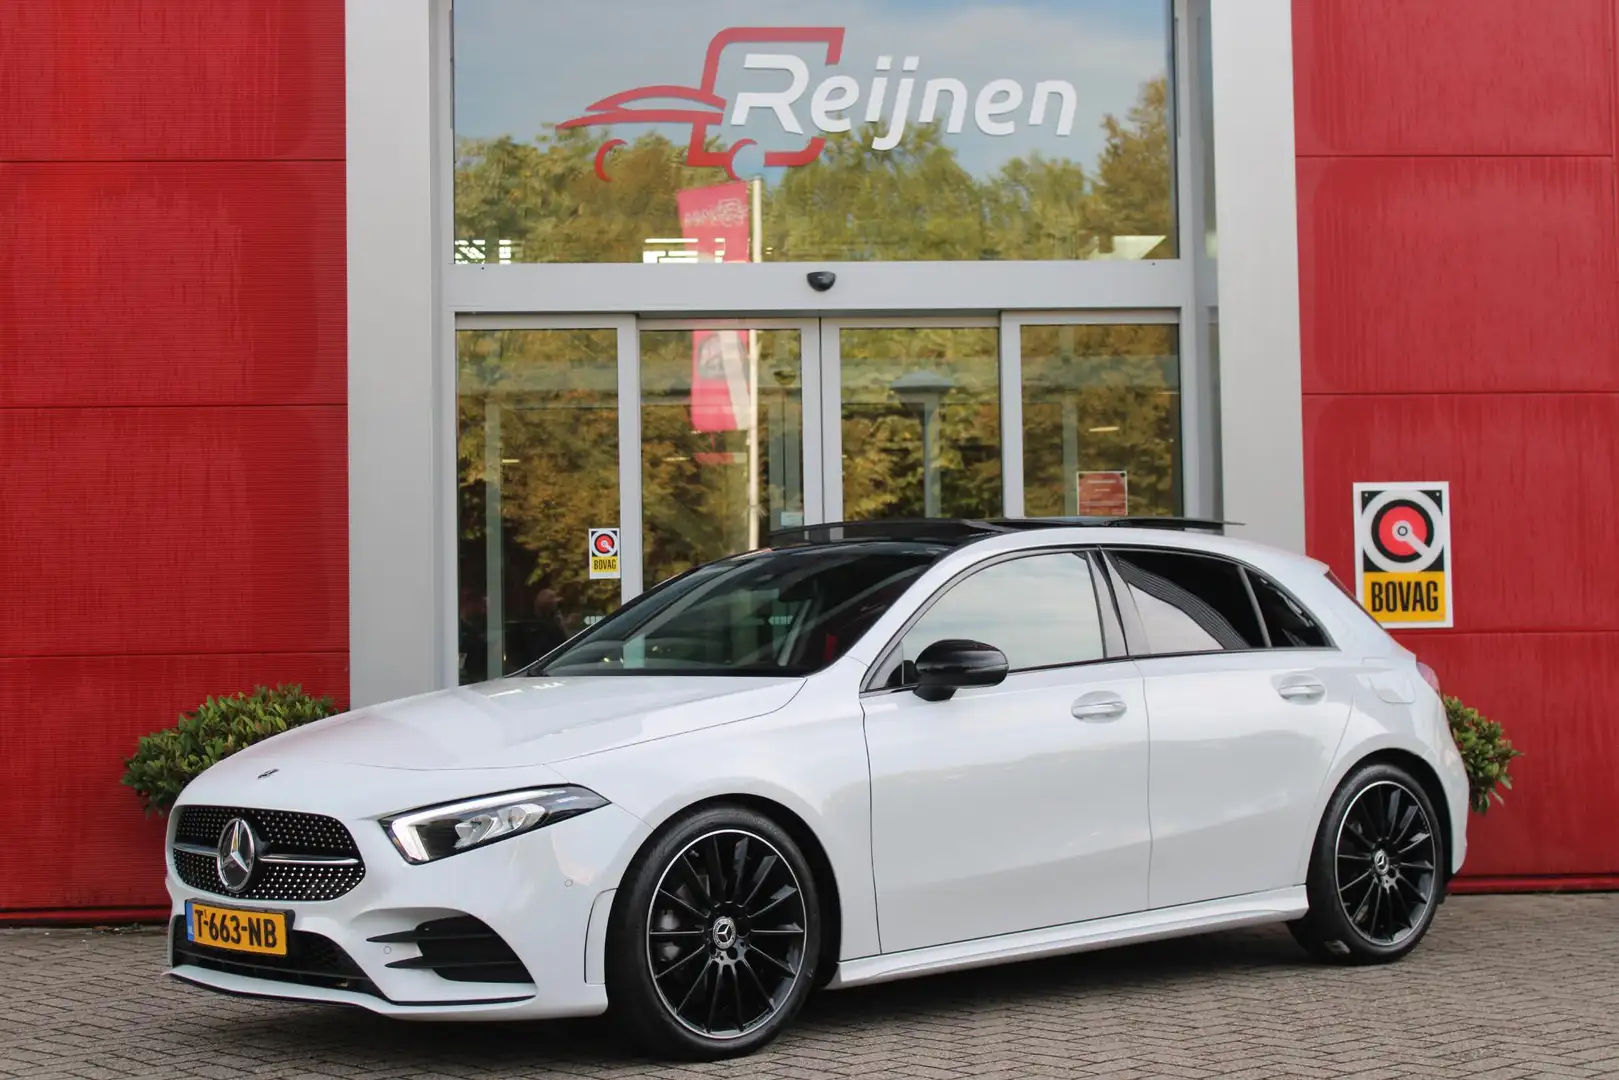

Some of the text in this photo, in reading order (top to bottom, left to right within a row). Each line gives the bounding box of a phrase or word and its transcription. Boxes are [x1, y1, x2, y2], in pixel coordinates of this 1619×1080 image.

[731, 54, 1077, 150] Reijnen
[593, 559, 616, 570] BOVAG
[1371, 581, 1438, 612] BOVAG
[195, 909, 277, 948] T-663-NB
